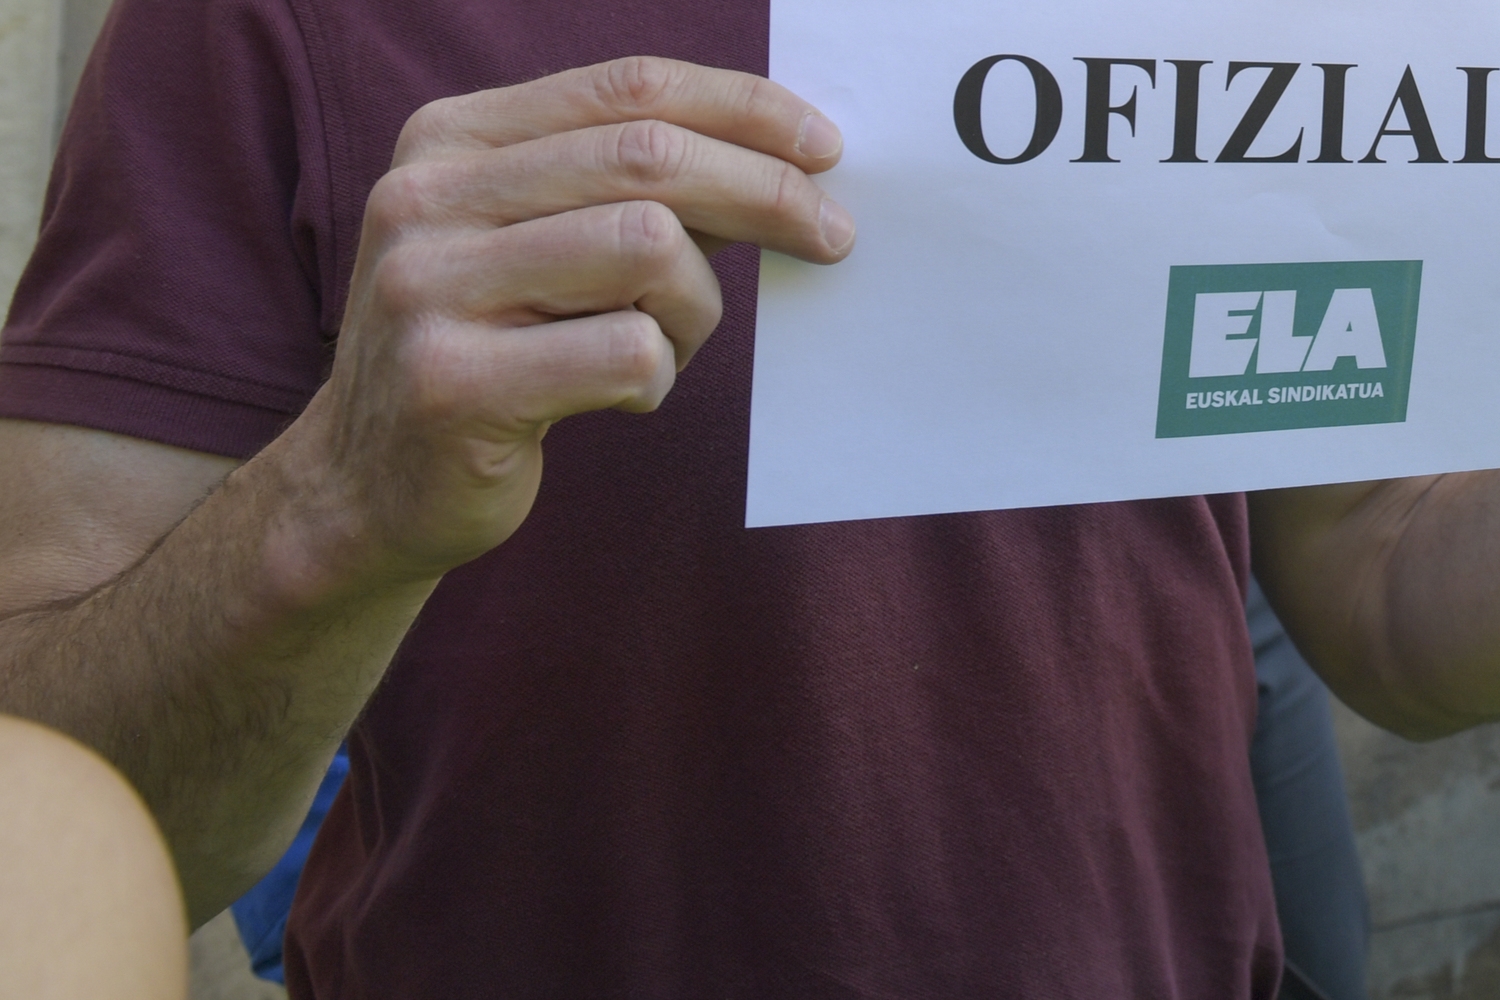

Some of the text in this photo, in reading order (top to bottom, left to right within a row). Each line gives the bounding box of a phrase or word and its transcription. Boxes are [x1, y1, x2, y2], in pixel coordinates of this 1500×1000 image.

[1188, 287, 1388, 378] ELA
[1185, 381, 1385, 410] EUSKAL SINDIKATUA
